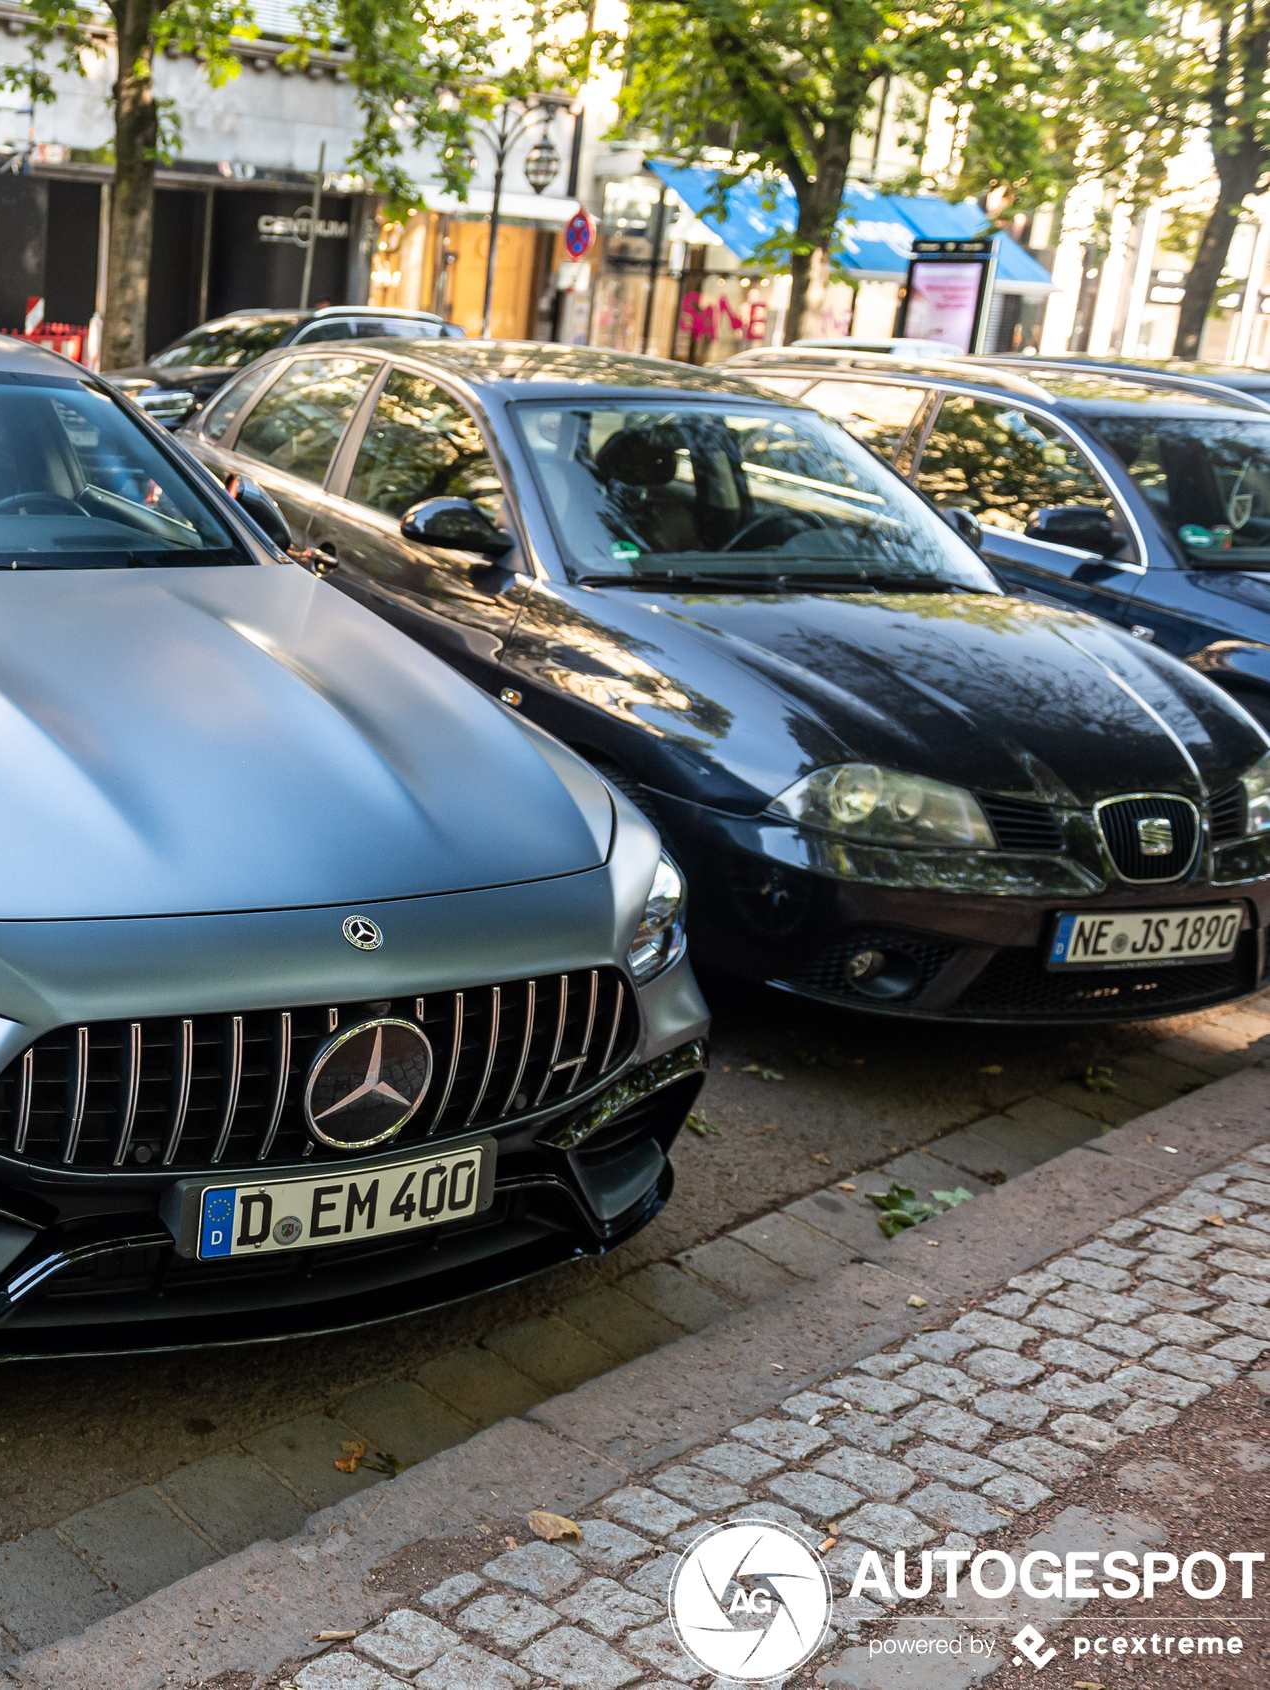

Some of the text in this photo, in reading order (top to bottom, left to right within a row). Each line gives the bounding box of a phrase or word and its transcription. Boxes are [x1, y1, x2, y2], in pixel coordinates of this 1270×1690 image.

[1071, 914, 1238, 957] NE JS 1890
[236, 1159, 476, 1246] D EM 400
[211, 1230, 223, 1245] D
